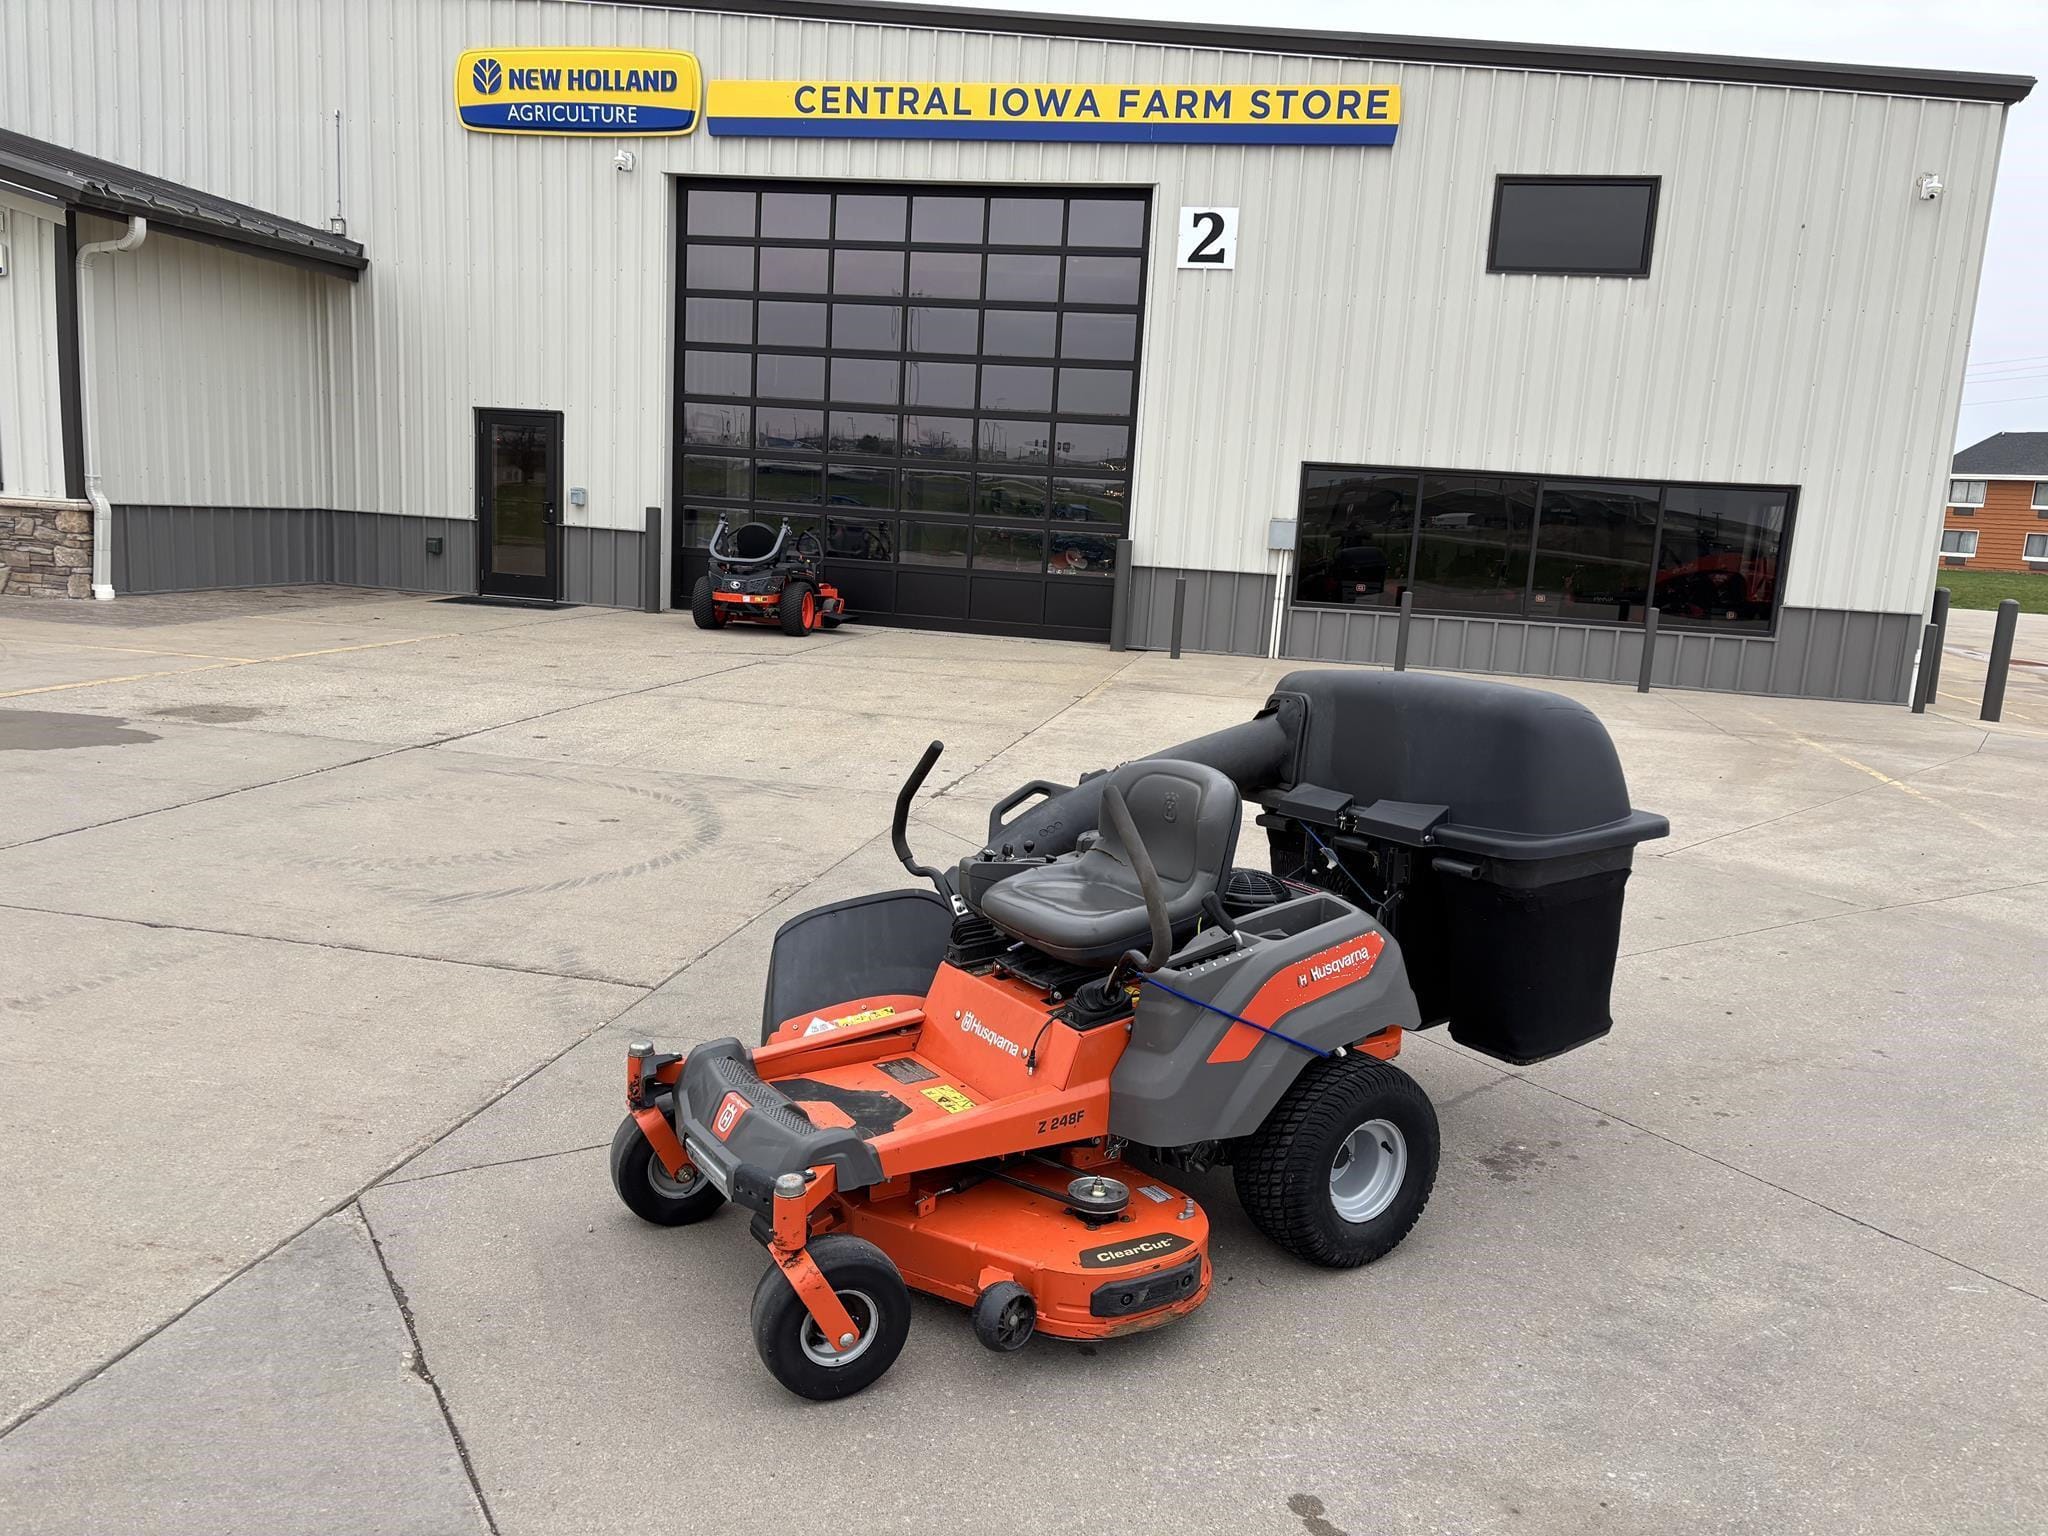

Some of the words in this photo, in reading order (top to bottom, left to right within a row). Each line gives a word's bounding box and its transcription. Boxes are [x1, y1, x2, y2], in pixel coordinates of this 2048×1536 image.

[508, 68, 562, 90] NEW
[567, 69, 678, 92] HOLLAND
[507, 103, 637, 124] AGRICULTURE
[794, 84, 972, 116] CENTRAL
[988, 86, 1101, 118] IOWA
[1117, 88, 1231, 120] FARM
[1248, 89, 1389, 120] STORE
[1186, 212, 1226, 264] 2
[1310, 946, 1370, 982] Husqvarna
[970, 1018, 1019, 1057] Husqvarna
[1037, 1120, 1047, 1135] Z
[1050, 1109, 1085, 1131] 248F
